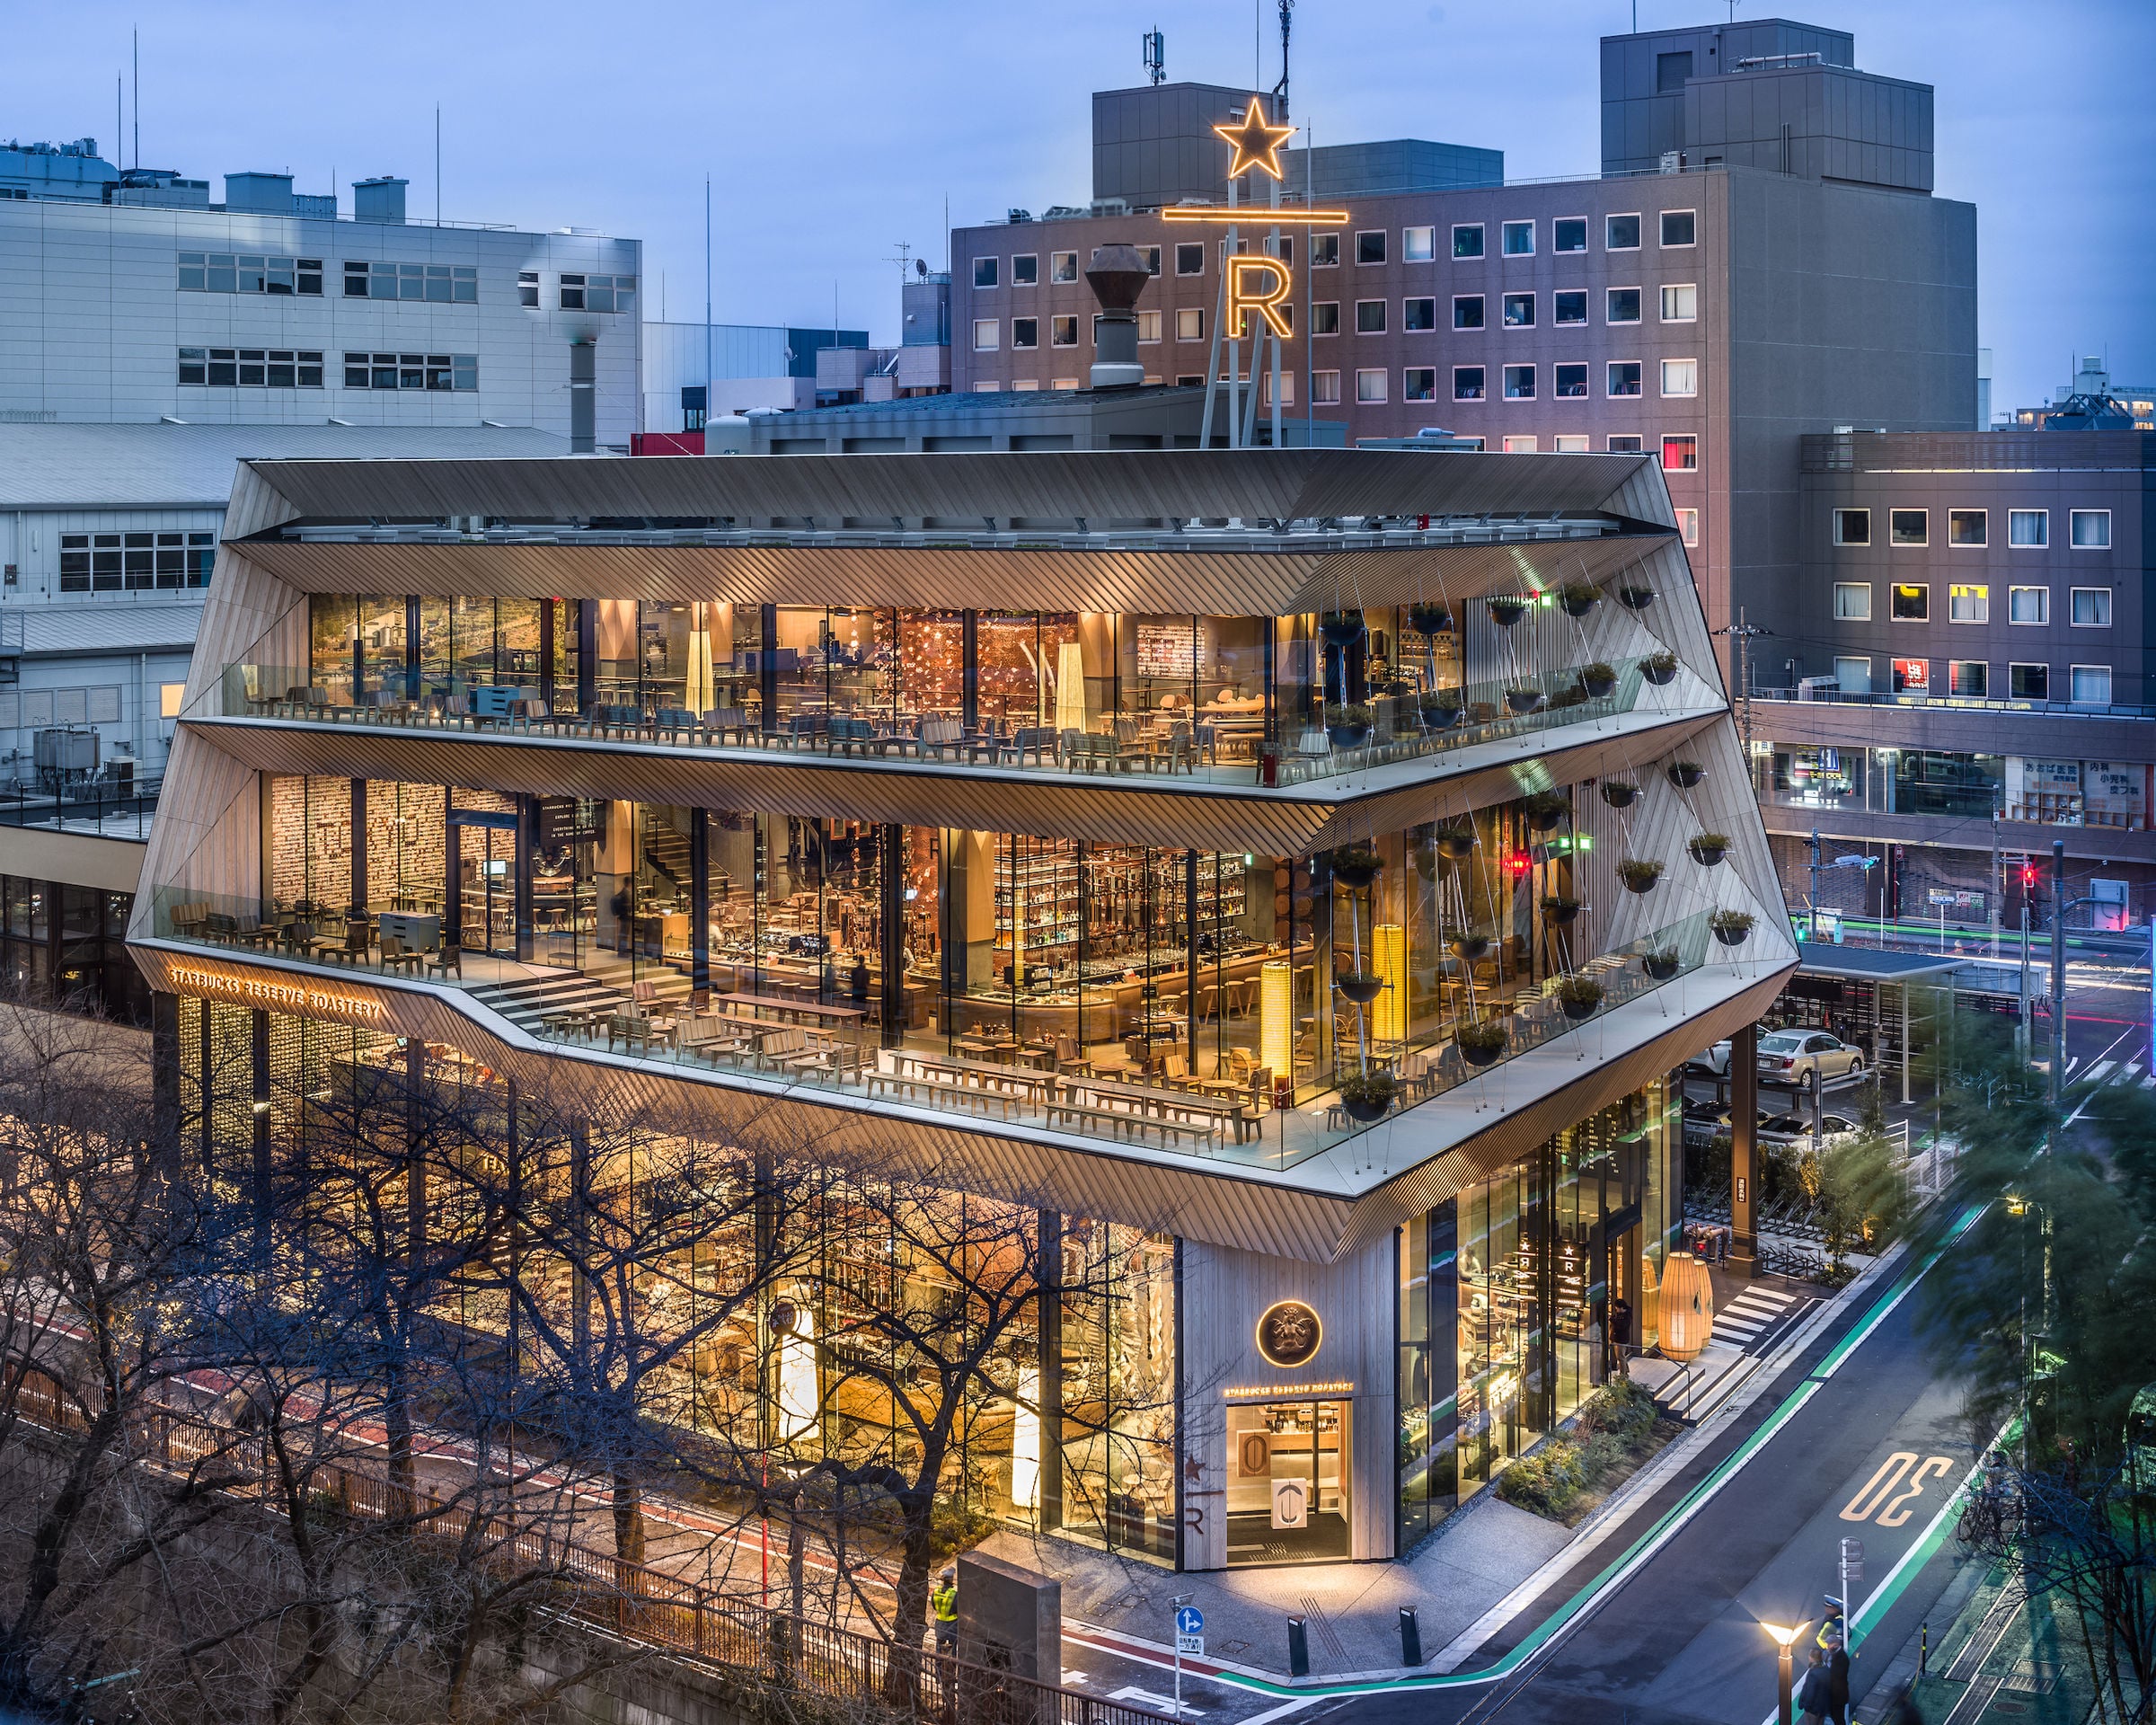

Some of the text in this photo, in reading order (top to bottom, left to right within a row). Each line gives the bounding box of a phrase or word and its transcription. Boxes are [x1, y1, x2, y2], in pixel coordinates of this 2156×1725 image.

[1228, 256, 1293, 338] R
[2026, 763, 2077, 774] あおば医院
[2090, 762, 2109, 772] 内科
[2100, 774, 2128, 783] 小児科
[169, 968, 382, 1019] STARBUCKS RESERVE ROASTERY
[1565, 1261, 1574, 1271] R
[1224, 1382, 1354, 1397] STARBUCKS RESERVE ROASTERY
[1839, 1452, 1955, 1526] 30
